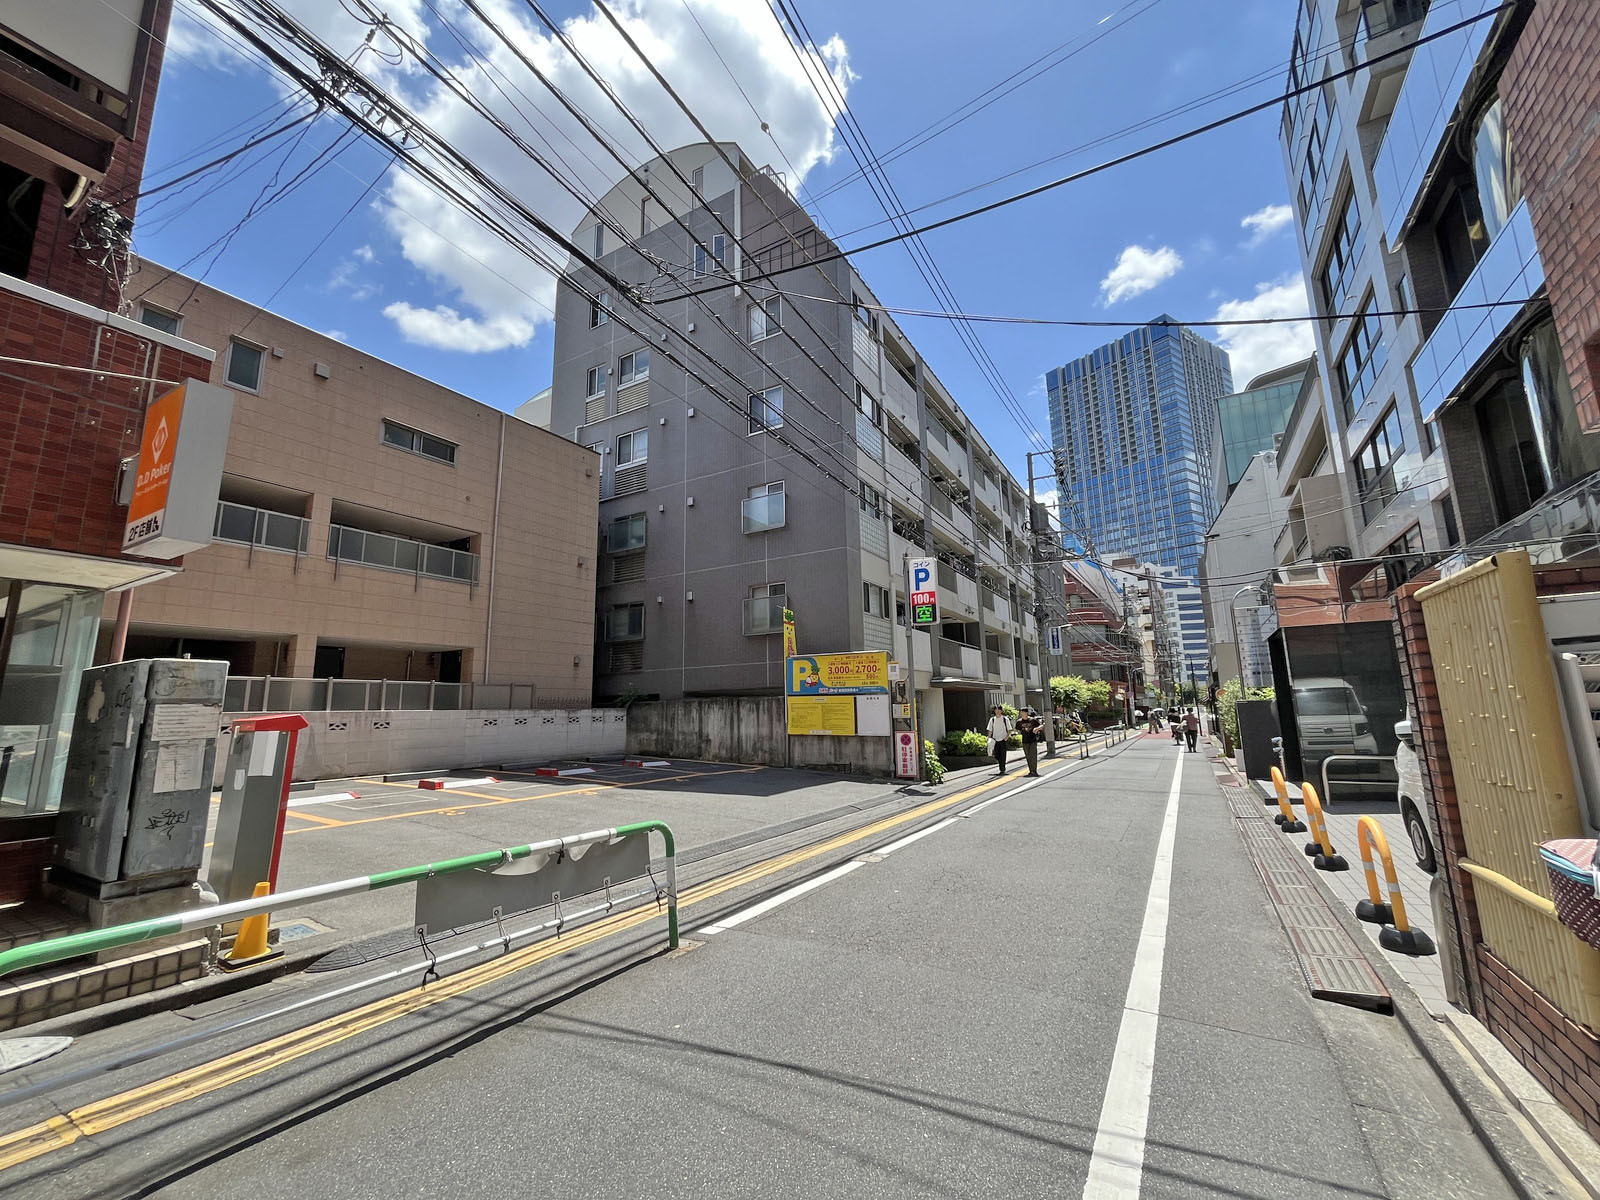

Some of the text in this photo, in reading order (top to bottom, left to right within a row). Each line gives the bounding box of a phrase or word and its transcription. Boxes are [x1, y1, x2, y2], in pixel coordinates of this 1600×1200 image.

[150, 463, 172, 481] Poker
[914, 567, 930, 591] P
[912, 593, 935, 605] 100円
[916, 605, 933, 622] 空
[792, 659, 812, 692] P
